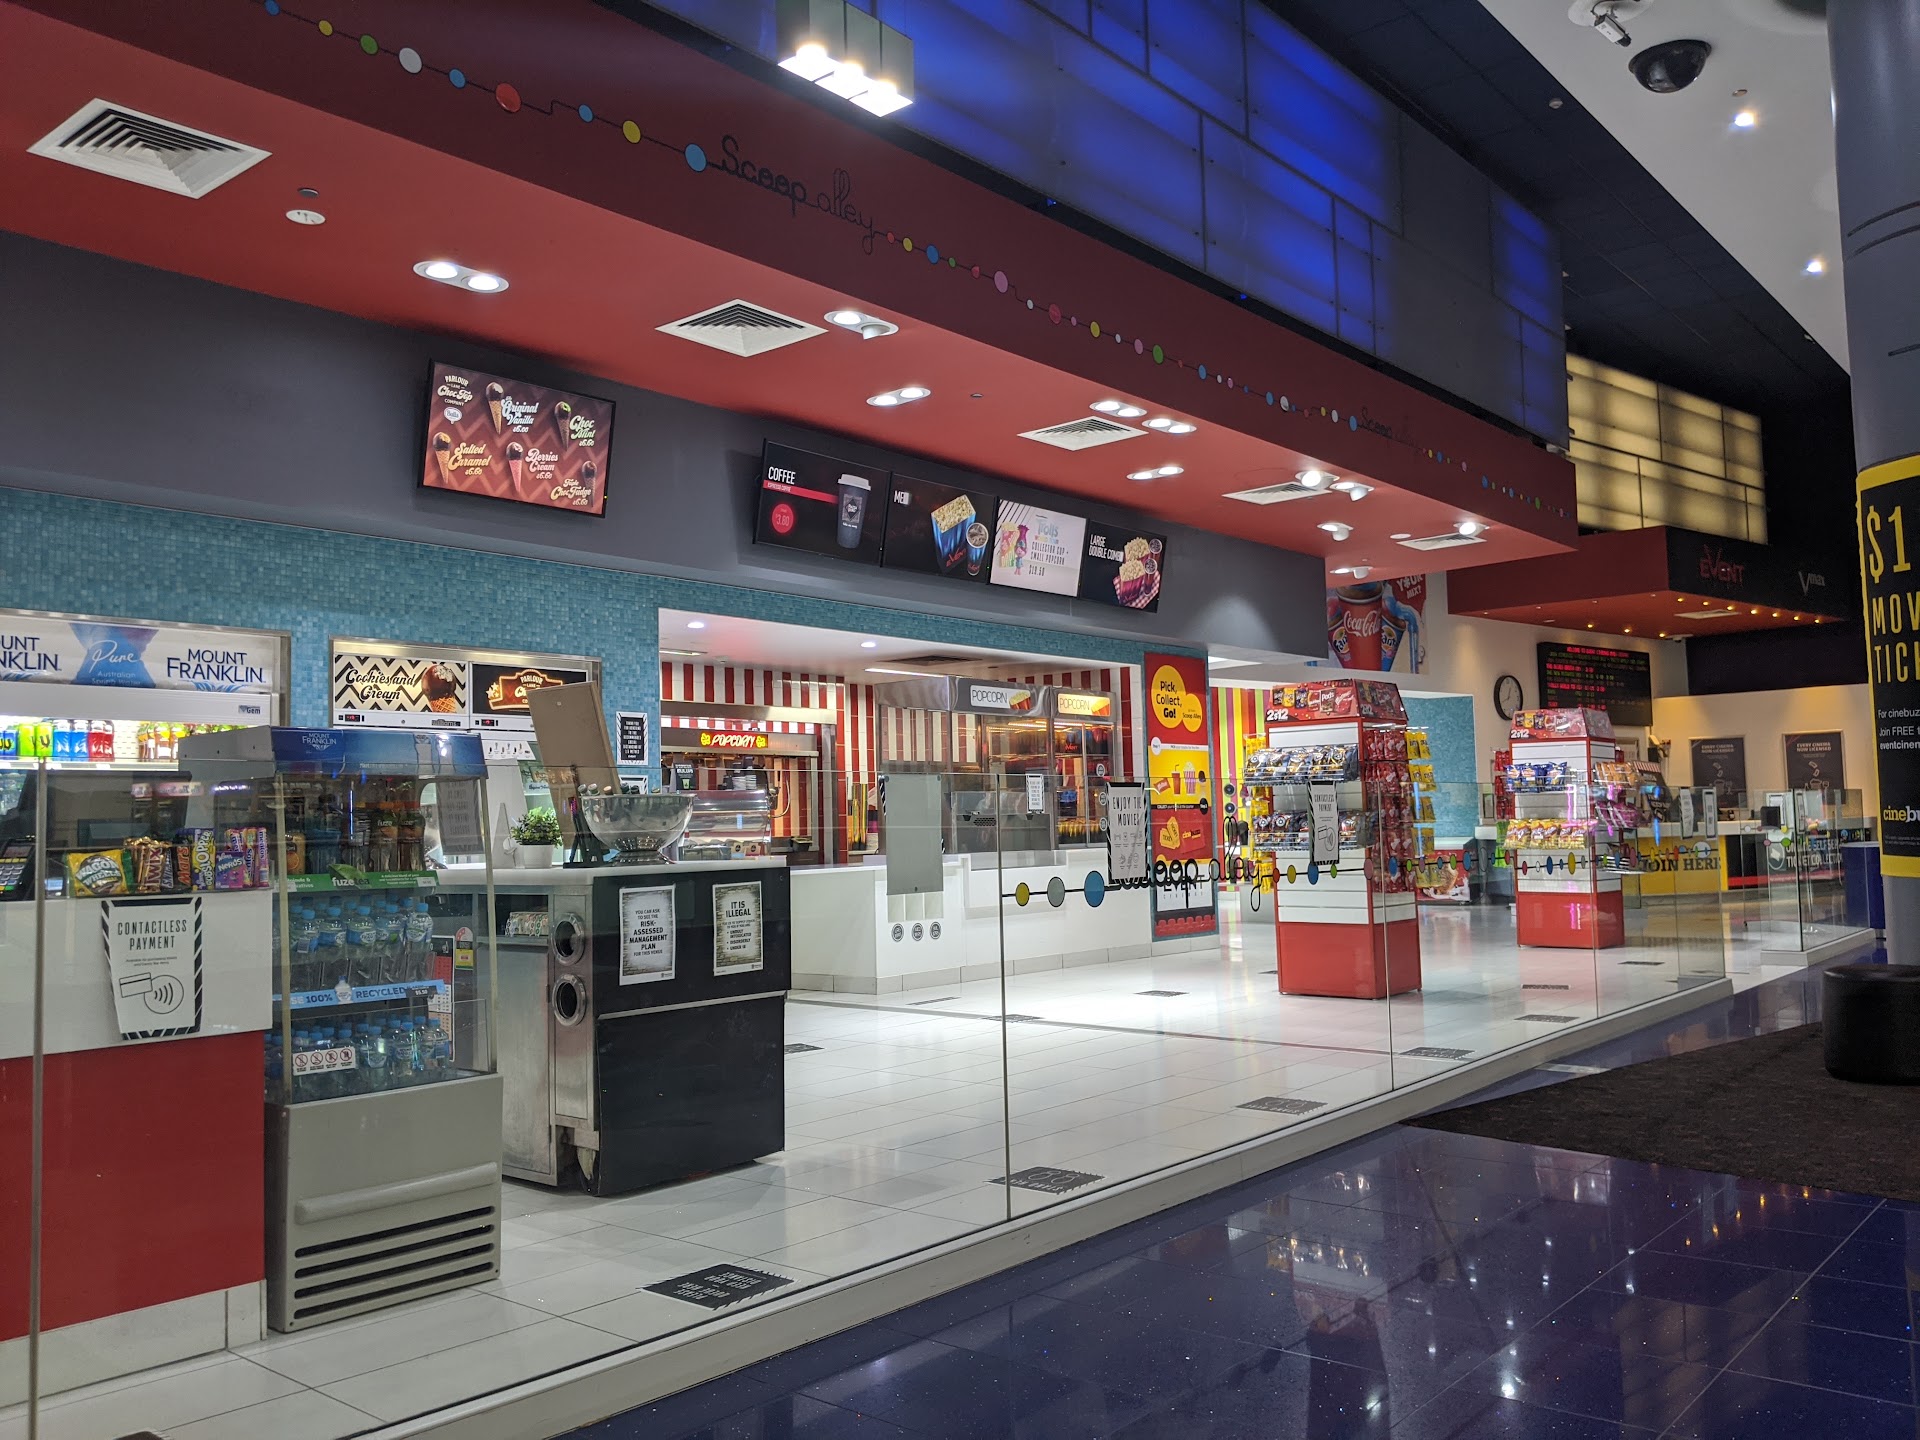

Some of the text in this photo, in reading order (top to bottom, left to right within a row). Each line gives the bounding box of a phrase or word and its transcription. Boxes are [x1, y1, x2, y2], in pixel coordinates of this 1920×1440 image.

[445, 376, 468, 387] PARLOUR
[502, 400, 539, 418] Original
[507, 413, 534, 425] Vanilla
[570, 416, 594, 430] Choc
[570, 429, 596, 439] Mint
[454, 442, 486, 454] Salted
[525, 448, 558, 462] Berries
[448, 454, 492, 470] Caramel
[529, 461, 554, 472] Cream
[768, 466, 796, 484] COFFEE
[1032, 542, 1056, 554] COLLECTOR
[1090, 534, 1106, 548] LARGE
[1030, 551, 1065, 566] SMALL POPCORN
[1088, 545, 1107, 558] DOUBLE
[89, 640, 140, 674] Pure
[188, 649, 248, 665] MOUNT
[167, 657, 264, 683] FRANKLIN
[346, 668, 416, 686] Cookies and
[520, 676, 543, 684] PARLOUR
[360, 685, 400, 700] Cream
[1160, 681, 1178, 694] Pick,
[972, 690, 1008, 704] POPCORN
[1156, 694, 1182, 708] Collect,
[1322, 692, 1334, 701] Pods
[246, 706, 261, 715] Gem
[1060, 698, 1090, 710] POPCORN
[1164, 708, 1176, 718] Go!
[1878, 710, 1887, 718] For
[1879, 726, 1914, 736] Join FREE
[302, 736, 337, 745] FRANKLIN
[711, 734, 756, 748] POPCORN
[1113, 797, 1130, 811] ENJOY
[1118, 814, 1139, 826] MOVIES
[75, 860, 119, 880] WAGON
[145, 846, 162, 887] TWIX
[726, 908, 751, 918] ILLEGAL
[118, 920, 187, 935] CONTACTLESS
[634, 927, 663, 935] ASSESSED
[130, 936, 175, 950] PAYMENT
[630, 934, 668, 943] MANAGEMENT
[306, 993, 333, 1004] 100%
[356, 987, 406, 999] RECYCLED
